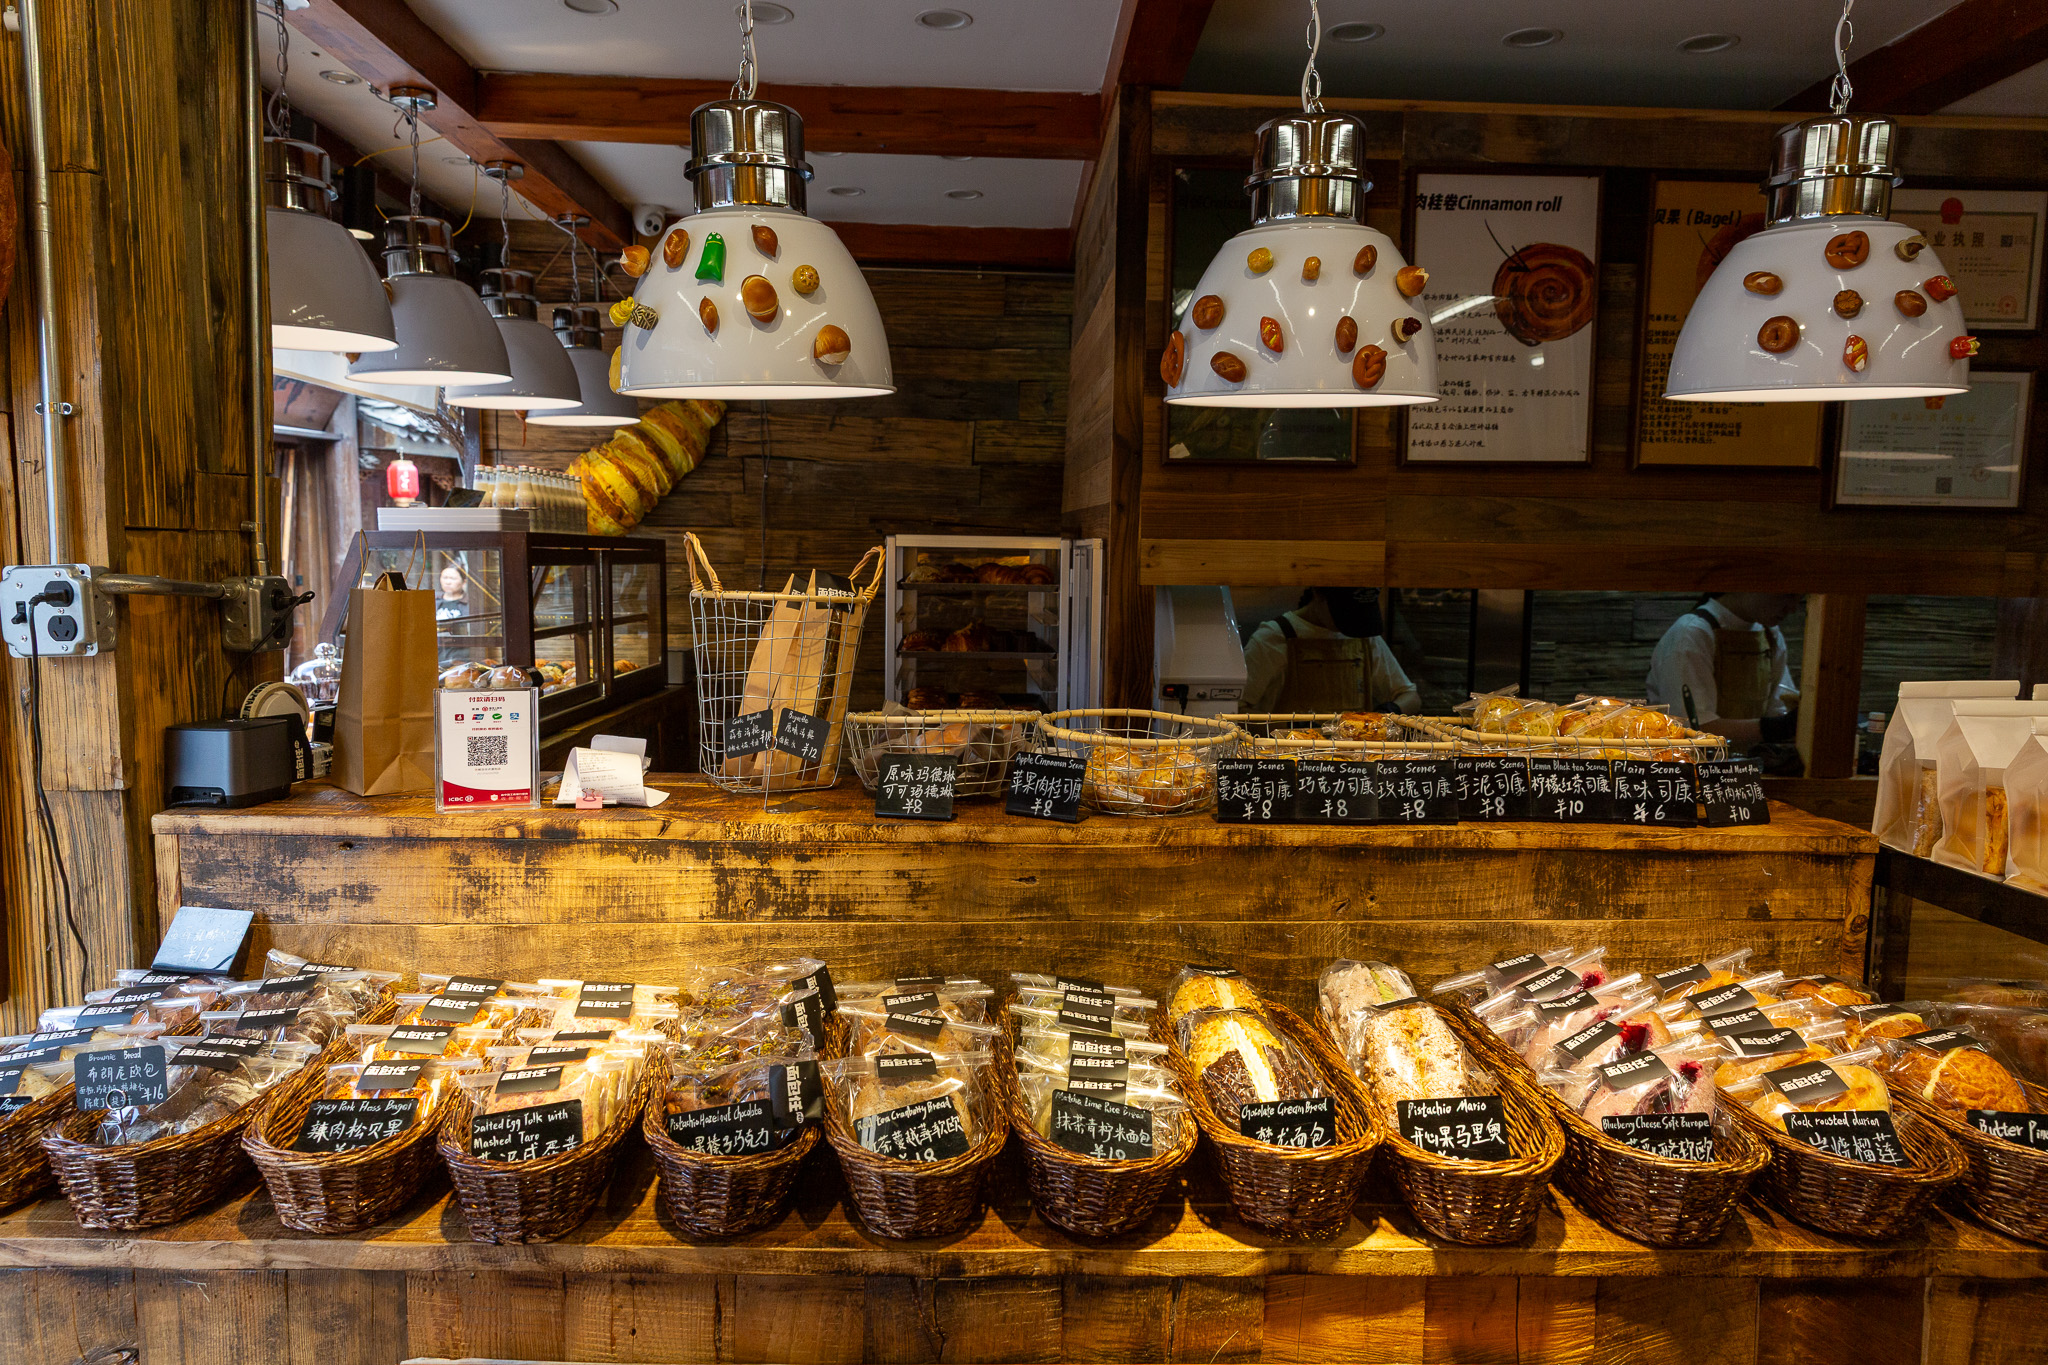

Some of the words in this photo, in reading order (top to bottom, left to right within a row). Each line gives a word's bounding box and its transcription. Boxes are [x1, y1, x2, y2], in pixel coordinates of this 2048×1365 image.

[1535, 196, 1562, 211] roll
[1921, 231, 1985, 247] 业执照
[1016, 753, 1036, 767] Apple
[1036, 754, 1068, 768] Cinnamon
[1217, 760, 1254, 776] Cranberry
[1257, 762, 1286, 771] Scones
[1298, 761, 1337, 774] Chocolate
[1339, 762, 1368, 775] Scone
[1376, 762, 1400, 775] Rose
[1404, 762, 1437, 775] Scones
[1453, 759, 1473, 771] Taro
[1571, 762, 1585, 771] tea
[1613, 760, 1647, 775] Plain
[1650, 763, 1682, 775] Scone
[883, 764, 957, 783] 原味玛德琳
[1720, 775, 1738, 783] Scone
[882, 784, 954, 799] 可可玛德琳
[1011, 769, 1083, 804] 苹果肉桂司康
[1218, 775, 1294, 803] 蔓越莓司康
[1298, 775, 1376, 798] 巧克力司康
[1377, 776, 1453, 800] 玫瑰司康
[1454, 772, 1528, 800] 芋泥司康
[1530, 773, 1612, 798] 柠檬红茶司康
[1614, 776, 1696, 803] 原味司康
[448, 983, 487, 993] 面包任
[1526, 972, 1559, 991] 面包任
[428, 998, 468, 1009] 面包任
[886, 994, 923, 1005] 面包任
[1066, 994, 1103, 1007] 面包任
[1698, 992, 1733, 1009] 面包任
[891, 1014, 930, 1025] 面包任
[1710, 1014, 1749, 1028] 面包任
[393, 1031, 435, 1041] 面包任
[1565, 1026, 1599, 1049] 面包任
[1740, 1032, 1781, 1046] 面包任
[1072, 1042, 1112, 1053] 面包任
[364, 1064, 407, 1077] 面包任
[880, 1058, 921, 1067] 面包任
[1073, 1058, 1112, 1068] 面包任
[1605, 1059, 1645, 1077] 面包任
[87, 1064, 160, 1081] 布朗尼欧包
[787, 1065, 804, 1113] 面包任
[1069, 1080, 1112, 1091] 面包任
[1780, 1074, 1824, 1092] 面包任
[338, 1101, 356, 1113] Pork
[876, 1115, 891, 1126] tea
[927, 1096, 951, 1113] Bread
[1084, 1097, 1102, 1111] Lime
[1104, 1101, 1121, 1114] Rice
[1407, 1100, 1452, 1119] Pistachio
[1456, 1098, 1487, 1113] Mario
[474, 1118, 504, 1134] Salted
[506, 1115, 521, 1132] Egg
[548, 1109, 569, 1122] with
[670, 1114, 700, 1132] Pistachio
[1055, 1109, 1152, 1147] 抹茶青柠米面包
[1602, 1117, 1635, 1136] Blueberry
[1635, 1115, 1661, 1129] Cheese
[1661, 1115, 1679, 1131] Soft
[1680, 1116, 1710, 1132] Europe
[1790, 1113, 1813, 1129] Rock
[1815, 1112, 1850, 1127] roasted
[1852, 1110, 1880, 1127] durian
[1978, 1118, 2024, 1138] Butter
[306, 1118, 403, 1143] 辣肉松贝果
[1410, 1117, 1506, 1149] 开心果马里奥
[473, 1134, 511, 1150] Mashed
[518, 1131, 540, 1145] Taro
[1809, 1131, 1903, 1166] 岩烧榴莲
[1615, 1136, 1716, 1163] 乳酪软欧
